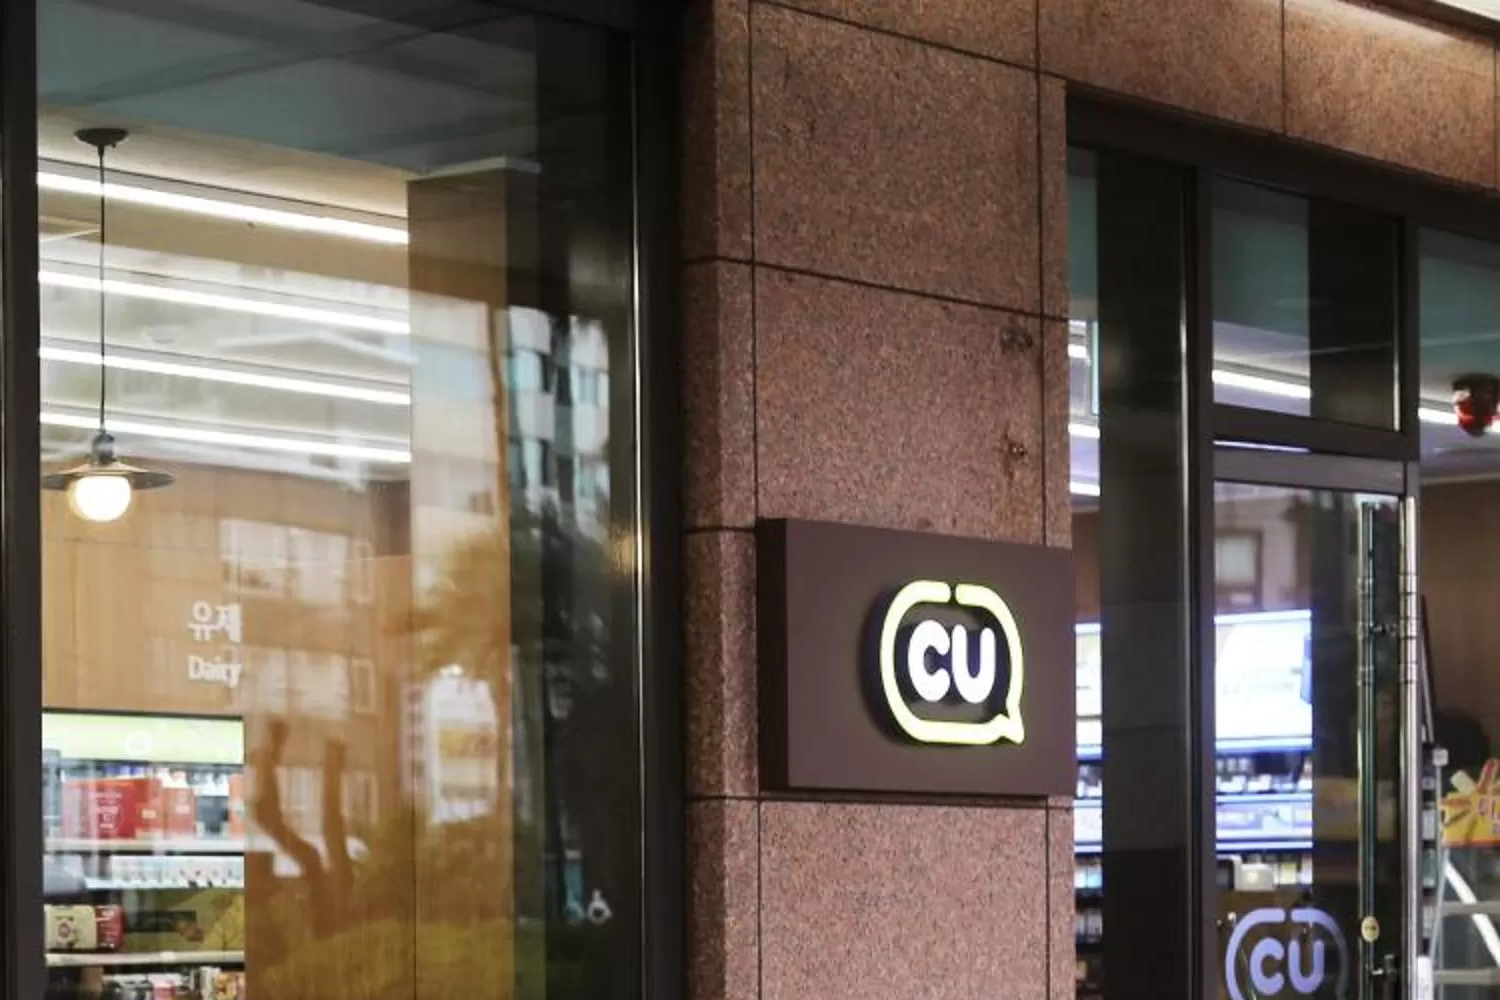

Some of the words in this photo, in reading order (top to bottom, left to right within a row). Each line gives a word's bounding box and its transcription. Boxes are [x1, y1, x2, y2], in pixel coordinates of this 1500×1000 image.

[188, 655, 242, 688] Dairy
[907, 619, 996, 703] CU
[1249, 938, 1324, 995] CU
